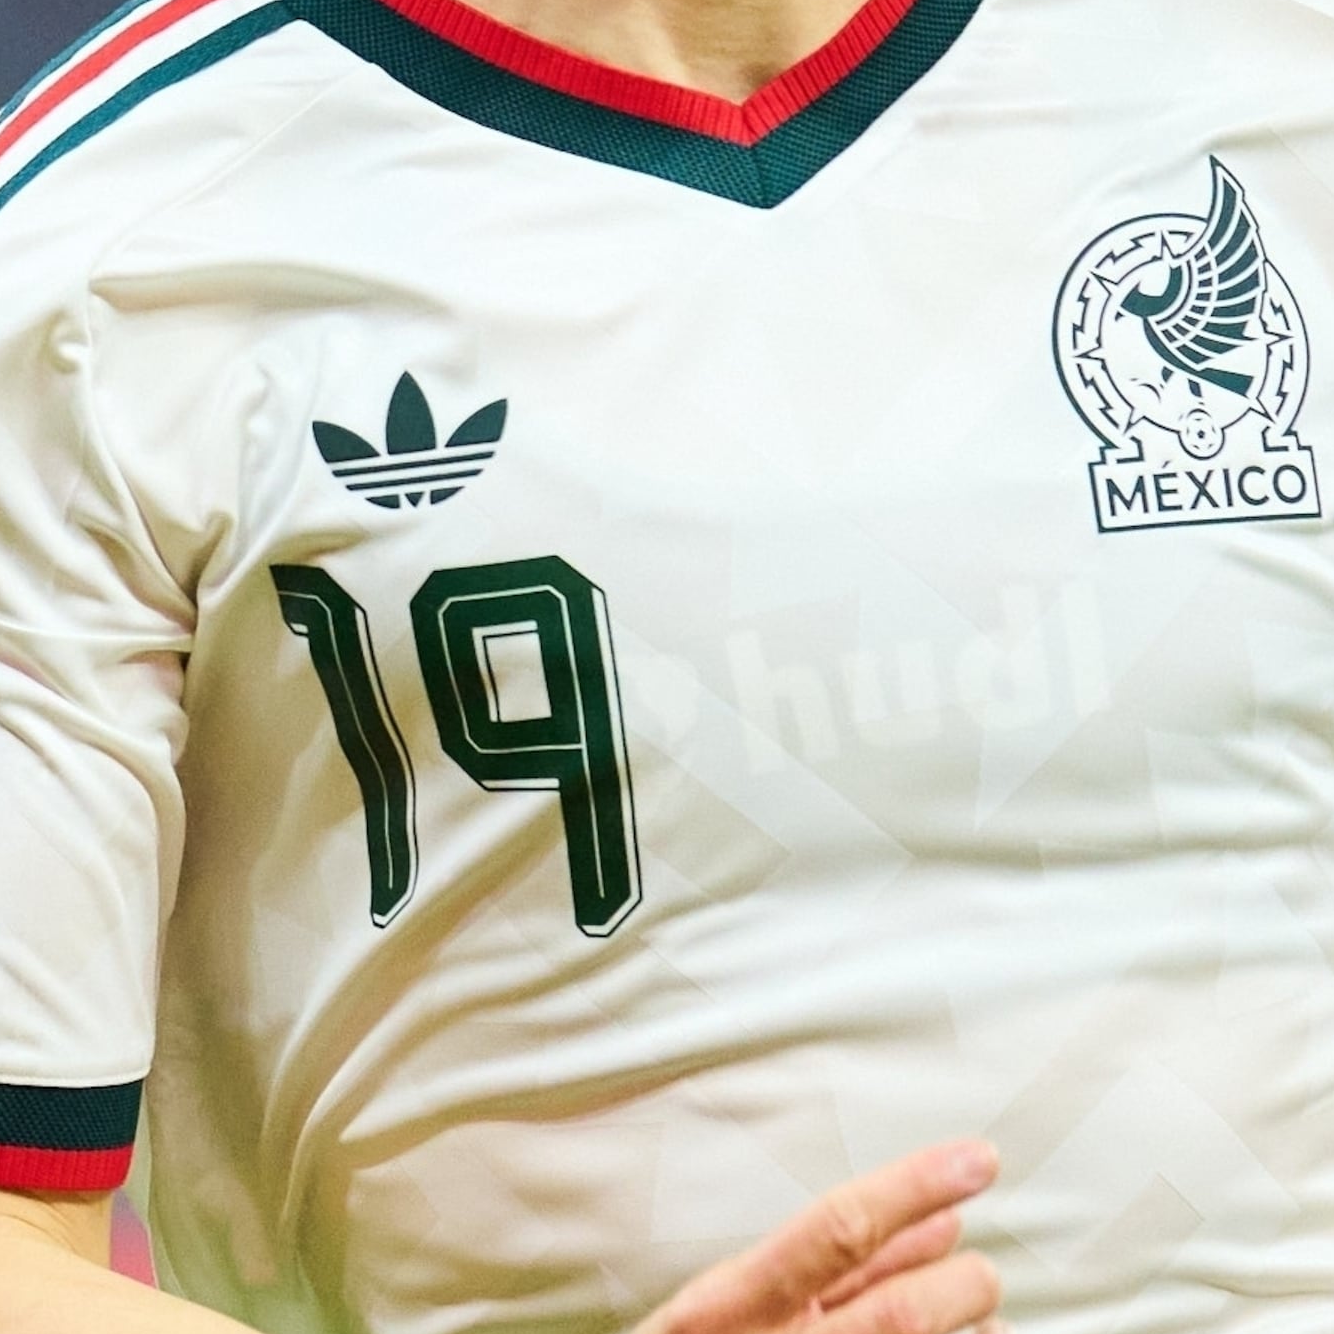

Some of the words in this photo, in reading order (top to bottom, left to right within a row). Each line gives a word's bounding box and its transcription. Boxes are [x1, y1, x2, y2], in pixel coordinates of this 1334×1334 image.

[1105, 461, 1308, 517] MÉXICO
[270, 554, 644, 939] 19
[723, 575, 1113, 778] hudl
